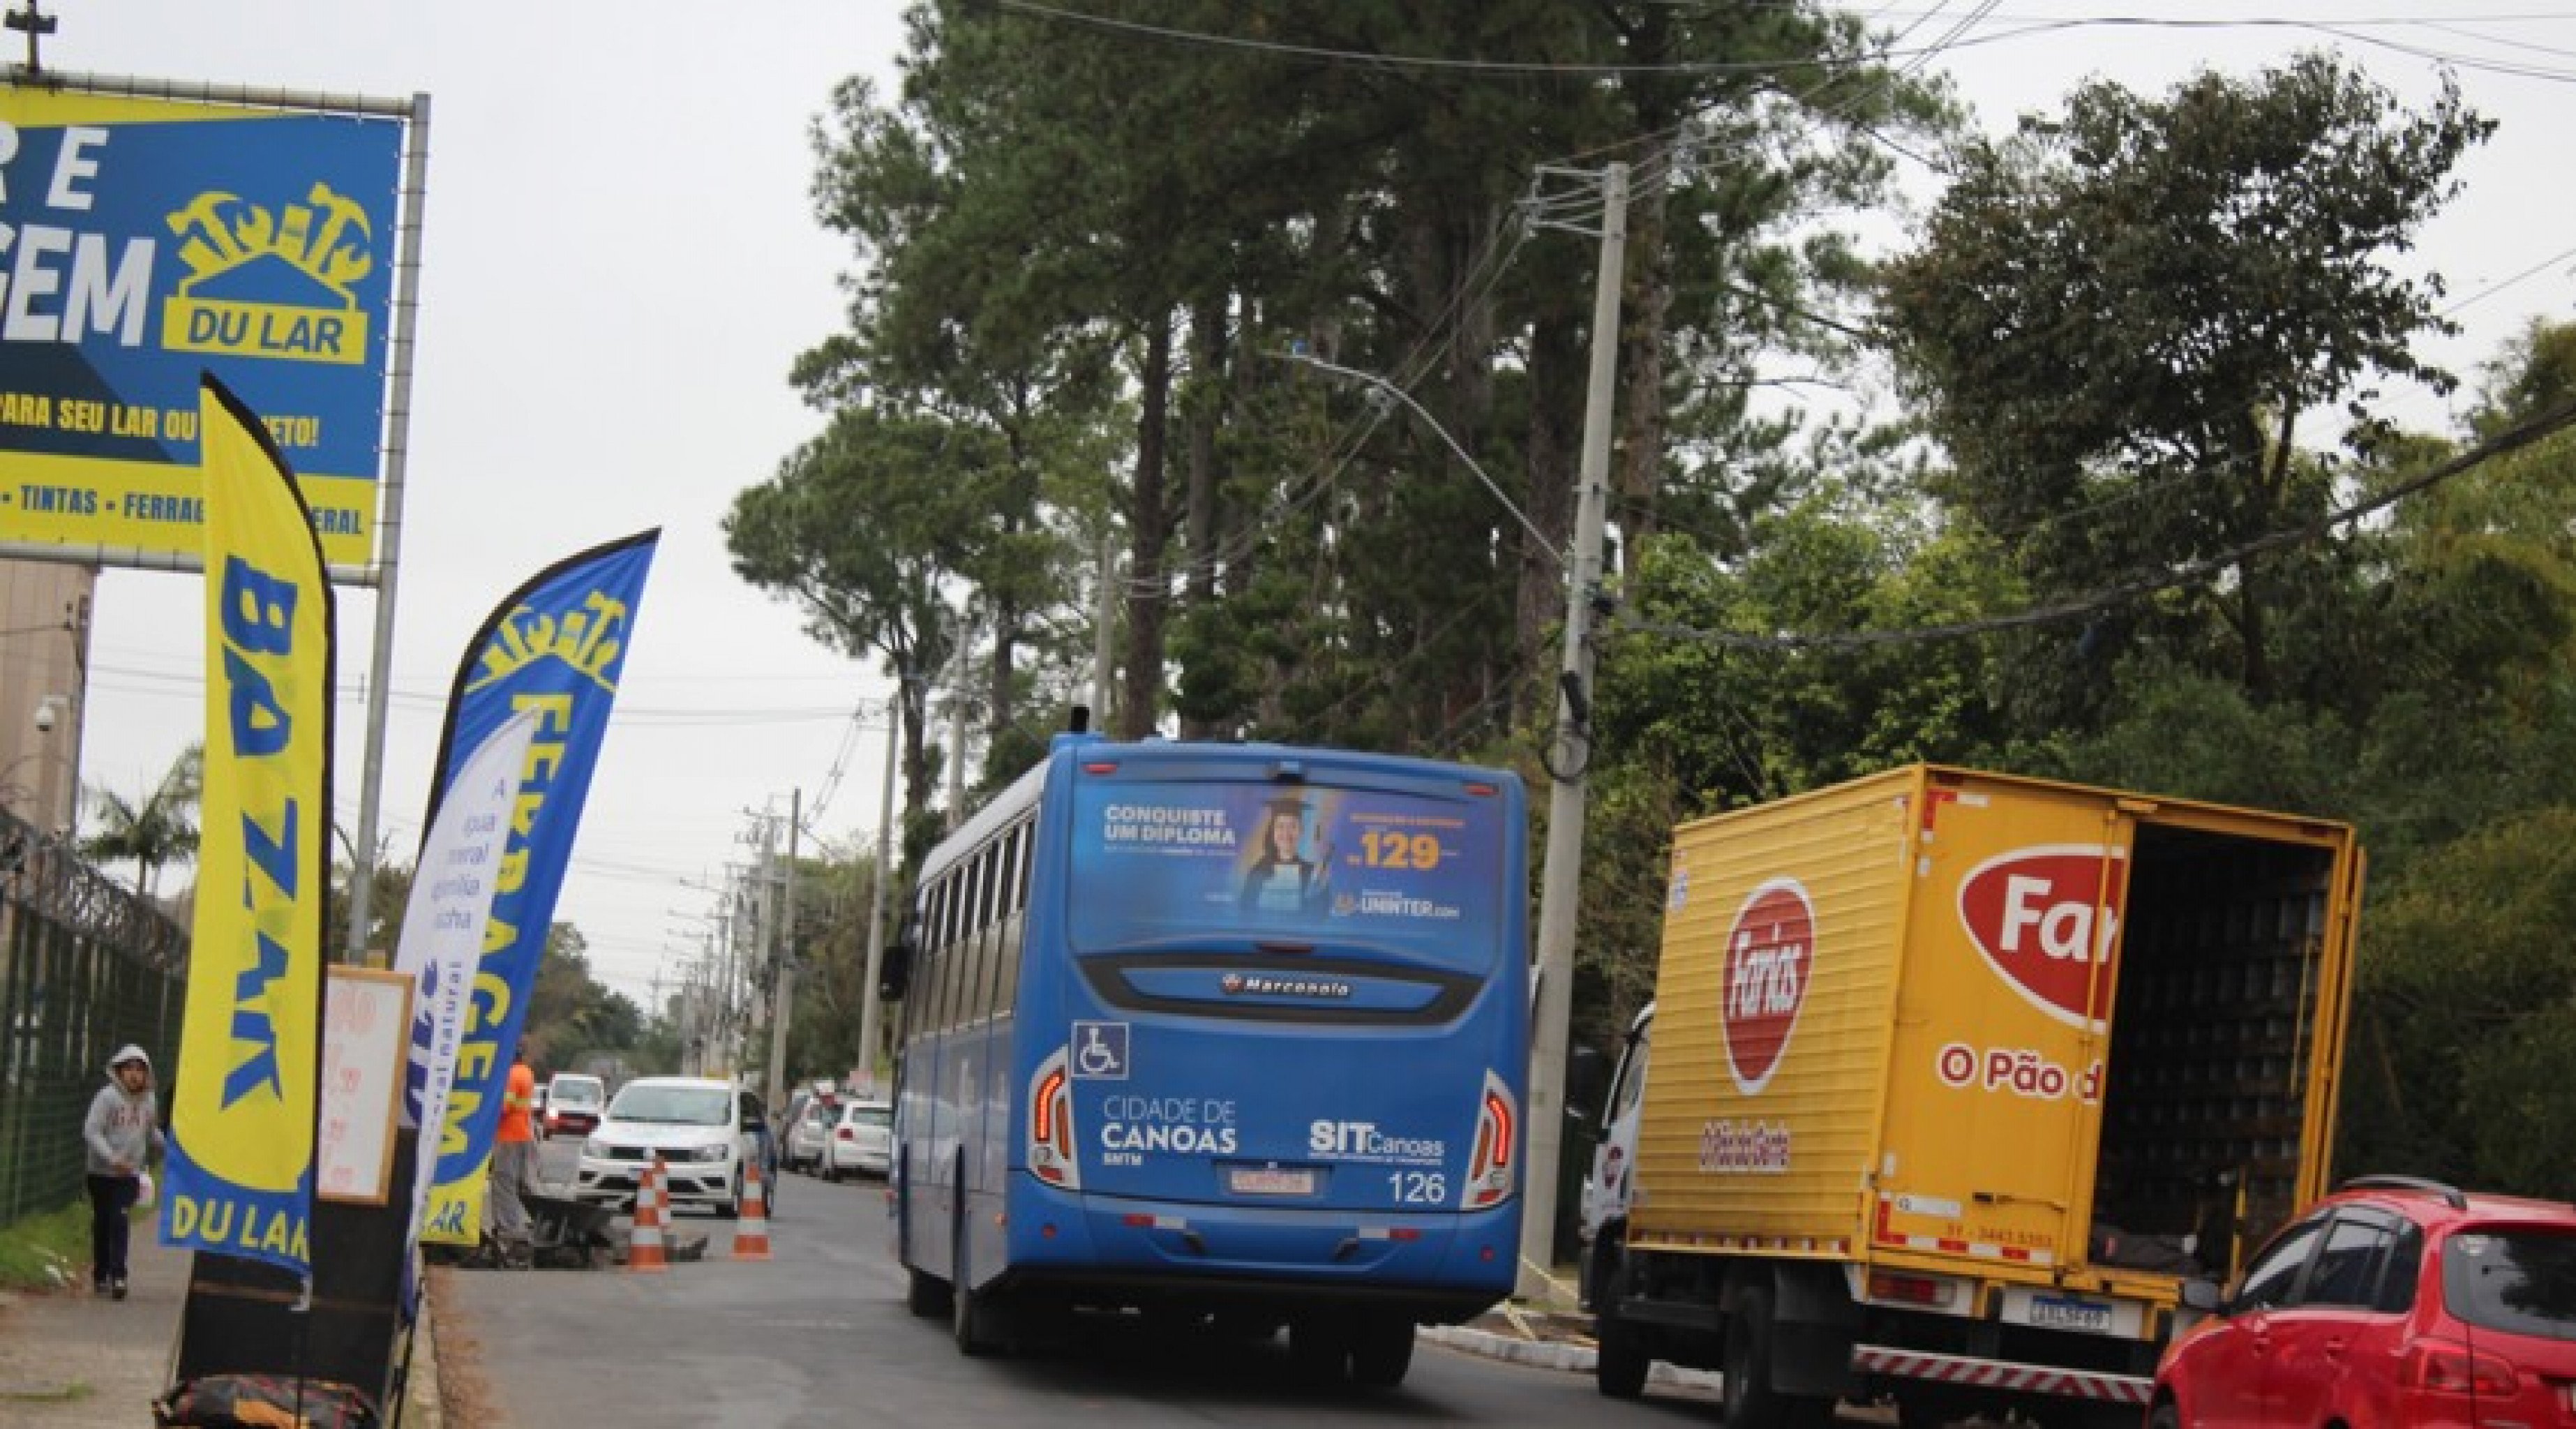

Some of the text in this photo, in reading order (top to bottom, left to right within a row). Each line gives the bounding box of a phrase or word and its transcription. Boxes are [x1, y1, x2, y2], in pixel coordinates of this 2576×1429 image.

[46, 126, 109, 210] E
[0, 220, 156, 347] EM
[188, 306, 343, 355] DU LAR
[58, 400, 103, 435] SEU
[112, 403, 158, 438] LAR
[164, 410, 197, 442] OU
[261, 415, 320, 447] ETO!
[20, 484, 98, 516] TINTAS
[311, 506, 364, 535] ERAL
[1104, 802, 1227, 827] CONQUISTE
[1104, 823, 1236, 847] UM DIPLOMA
[1360, 830, 1440, 871] 129
[1245, 976, 1350, 998] Marcopolo
[1939, 1046, 1976, 1085] O
[1986, 1049, 2066, 1095] Pão
[1103, 1095, 1236, 1125] CIDADE DE
[1101, 1122, 1238, 1154] CANOAS
[1386, 1170, 1446, 1204] 126
[172, 1194, 236, 1243] DU
[421, 1200, 468, 1236] AR
